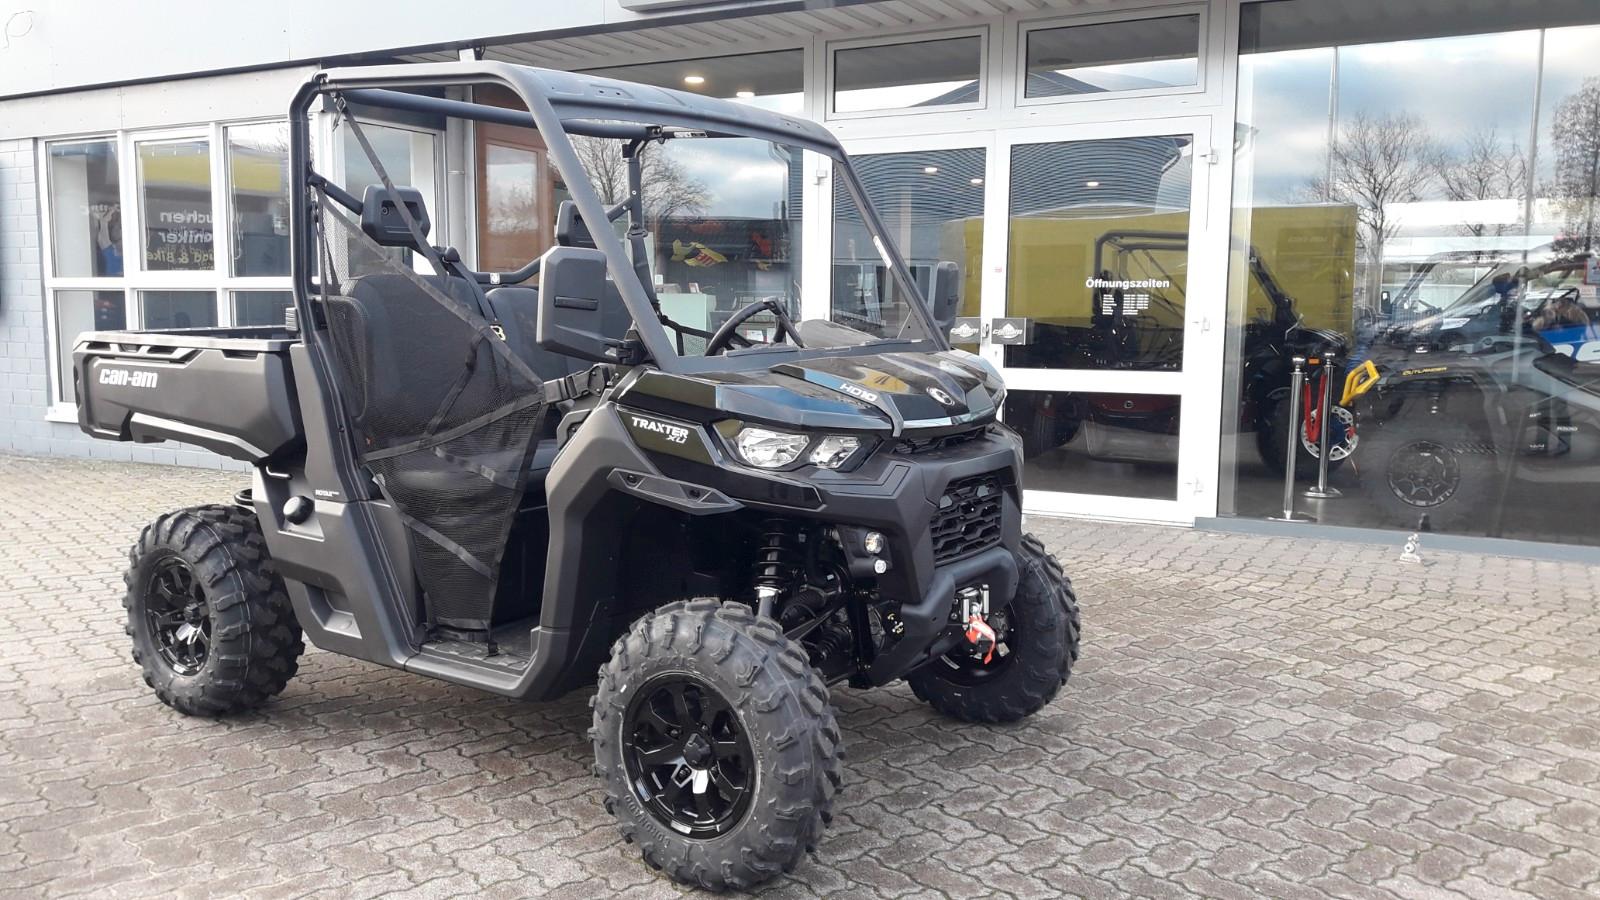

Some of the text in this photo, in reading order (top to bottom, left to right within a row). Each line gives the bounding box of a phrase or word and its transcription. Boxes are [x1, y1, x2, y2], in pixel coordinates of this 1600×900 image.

[1085, 276, 1170, 290] Öffnungszeiten
[99, 368, 158, 388] can-am
[839, 383, 878, 402] HD10
[631, 416, 689, 439] TRAXTER
